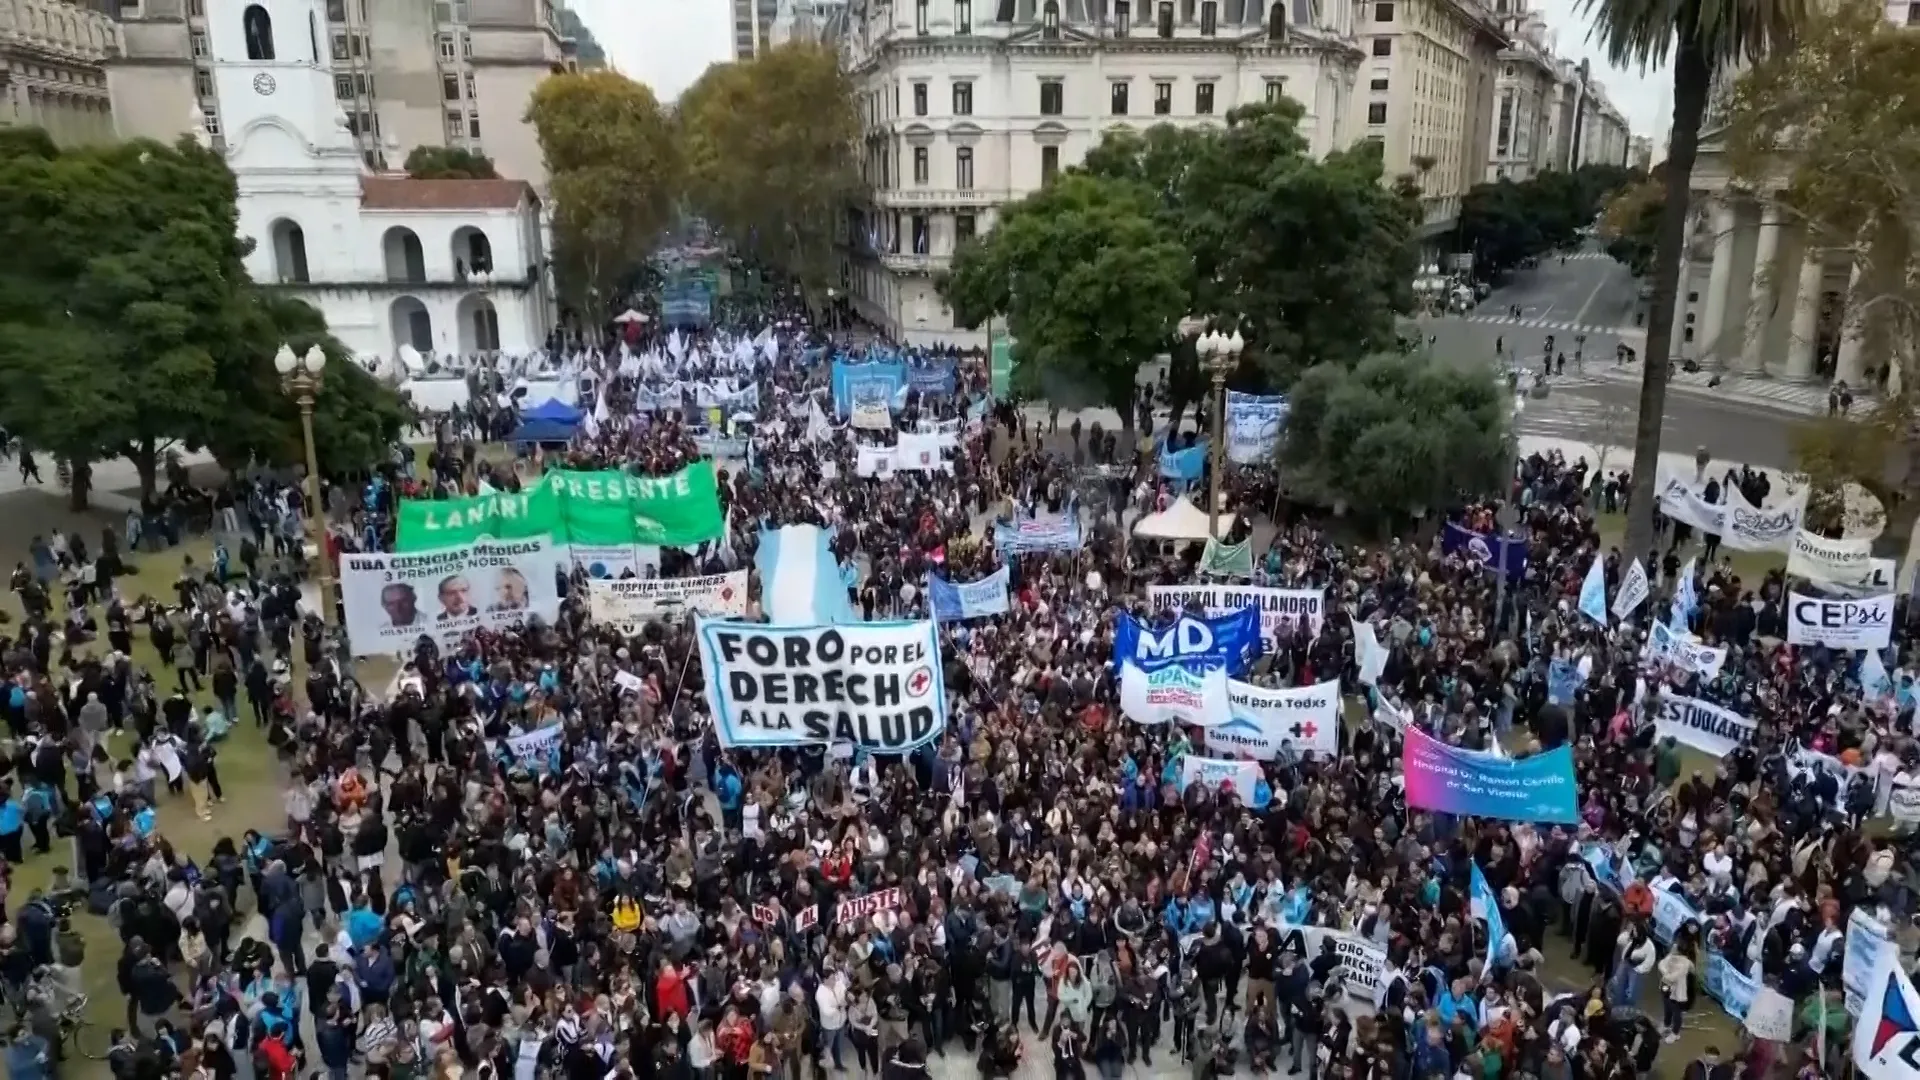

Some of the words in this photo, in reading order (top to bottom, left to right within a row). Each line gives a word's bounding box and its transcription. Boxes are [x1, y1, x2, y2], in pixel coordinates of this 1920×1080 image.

[425, 496, 529, 530] LANARI
[550, 474, 691, 505] PRESENTE
[349, 558, 385, 570] UBA
[390, 548, 468, 570] CIENCIAS
[384, 571, 393, 581] 3
[397, 563, 464, 580] PREMIOS
[468, 557, 514, 568] NOBEL
[611, 582, 658, 592] HOSPITAL
[1796, 601, 1887, 628] CEPsi
[717, 629, 844, 667] FORO
[850, 645, 897, 664] POR
[903, 641, 925, 663] EL
[1137, 617, 1214, 659] MD
[738, 708, 756, 726] A
[760, 710, 792, 730] LA
[803, 705, 934, 747] SALUD
[1209, 730, 1229, 741] San
[1413, 759, 1458, 775] Hospital
[1523, 774, 1565, 787] Carrillo
[1464, 783, 1484, 794] San
[1487, 786, 1529, 799] Vicente
[755, 906, 773, 922] NO
[802, 907, 817, 924] AL
[841, 888, 899, 920] AJUSTE
[1338, 943, 1363, 956] ORO
